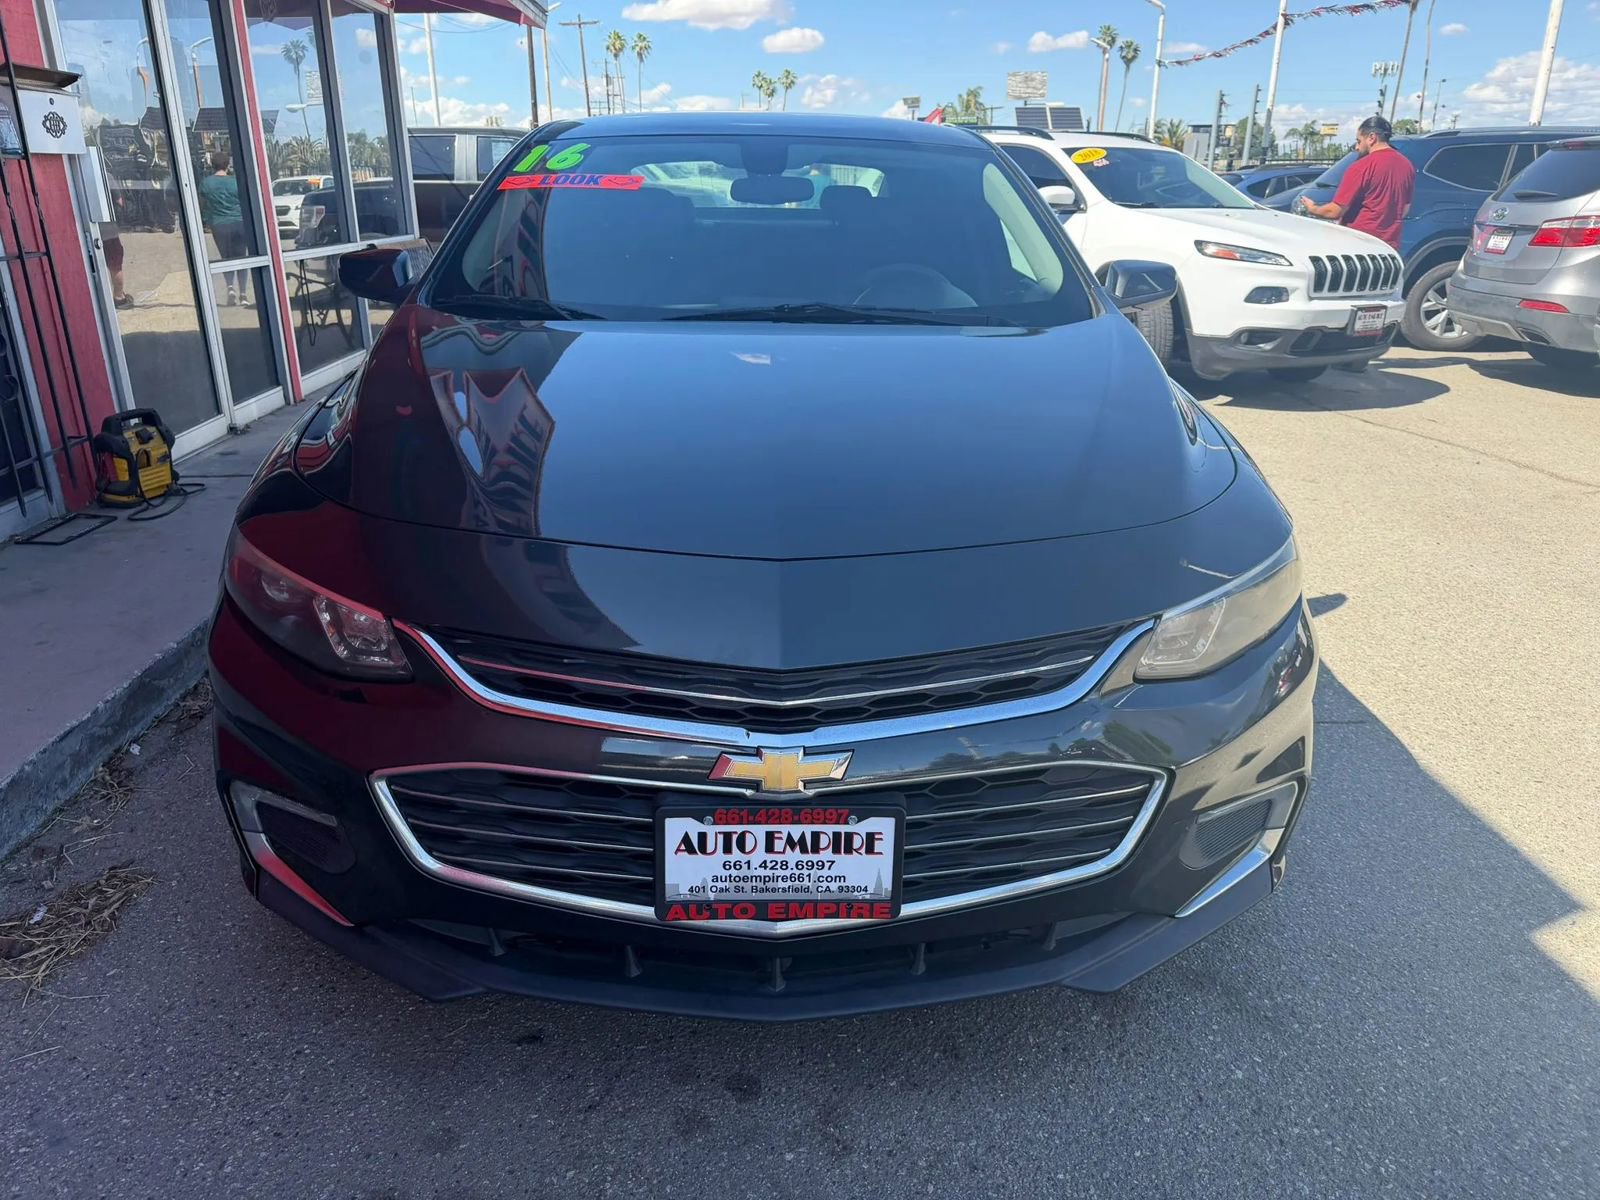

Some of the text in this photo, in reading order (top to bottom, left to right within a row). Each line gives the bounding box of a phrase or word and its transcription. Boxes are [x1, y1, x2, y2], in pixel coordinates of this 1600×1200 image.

[513, 143, 591, 172] 16
[538, 174, 604, 186] LOOK
[714, 808, 850, 825] 661-428-6997
[674, 830, 884, 856] AUTO EMPIRE
[722, 860, 836, 871] 661.428.6997
[711, 873, 846, 886] autoempire661.com
[688, 885, 868, 896] 401 Oak St. Bakersfield, CA. 93304
[665, 902, 891, 921] AUTO EMPIRE
